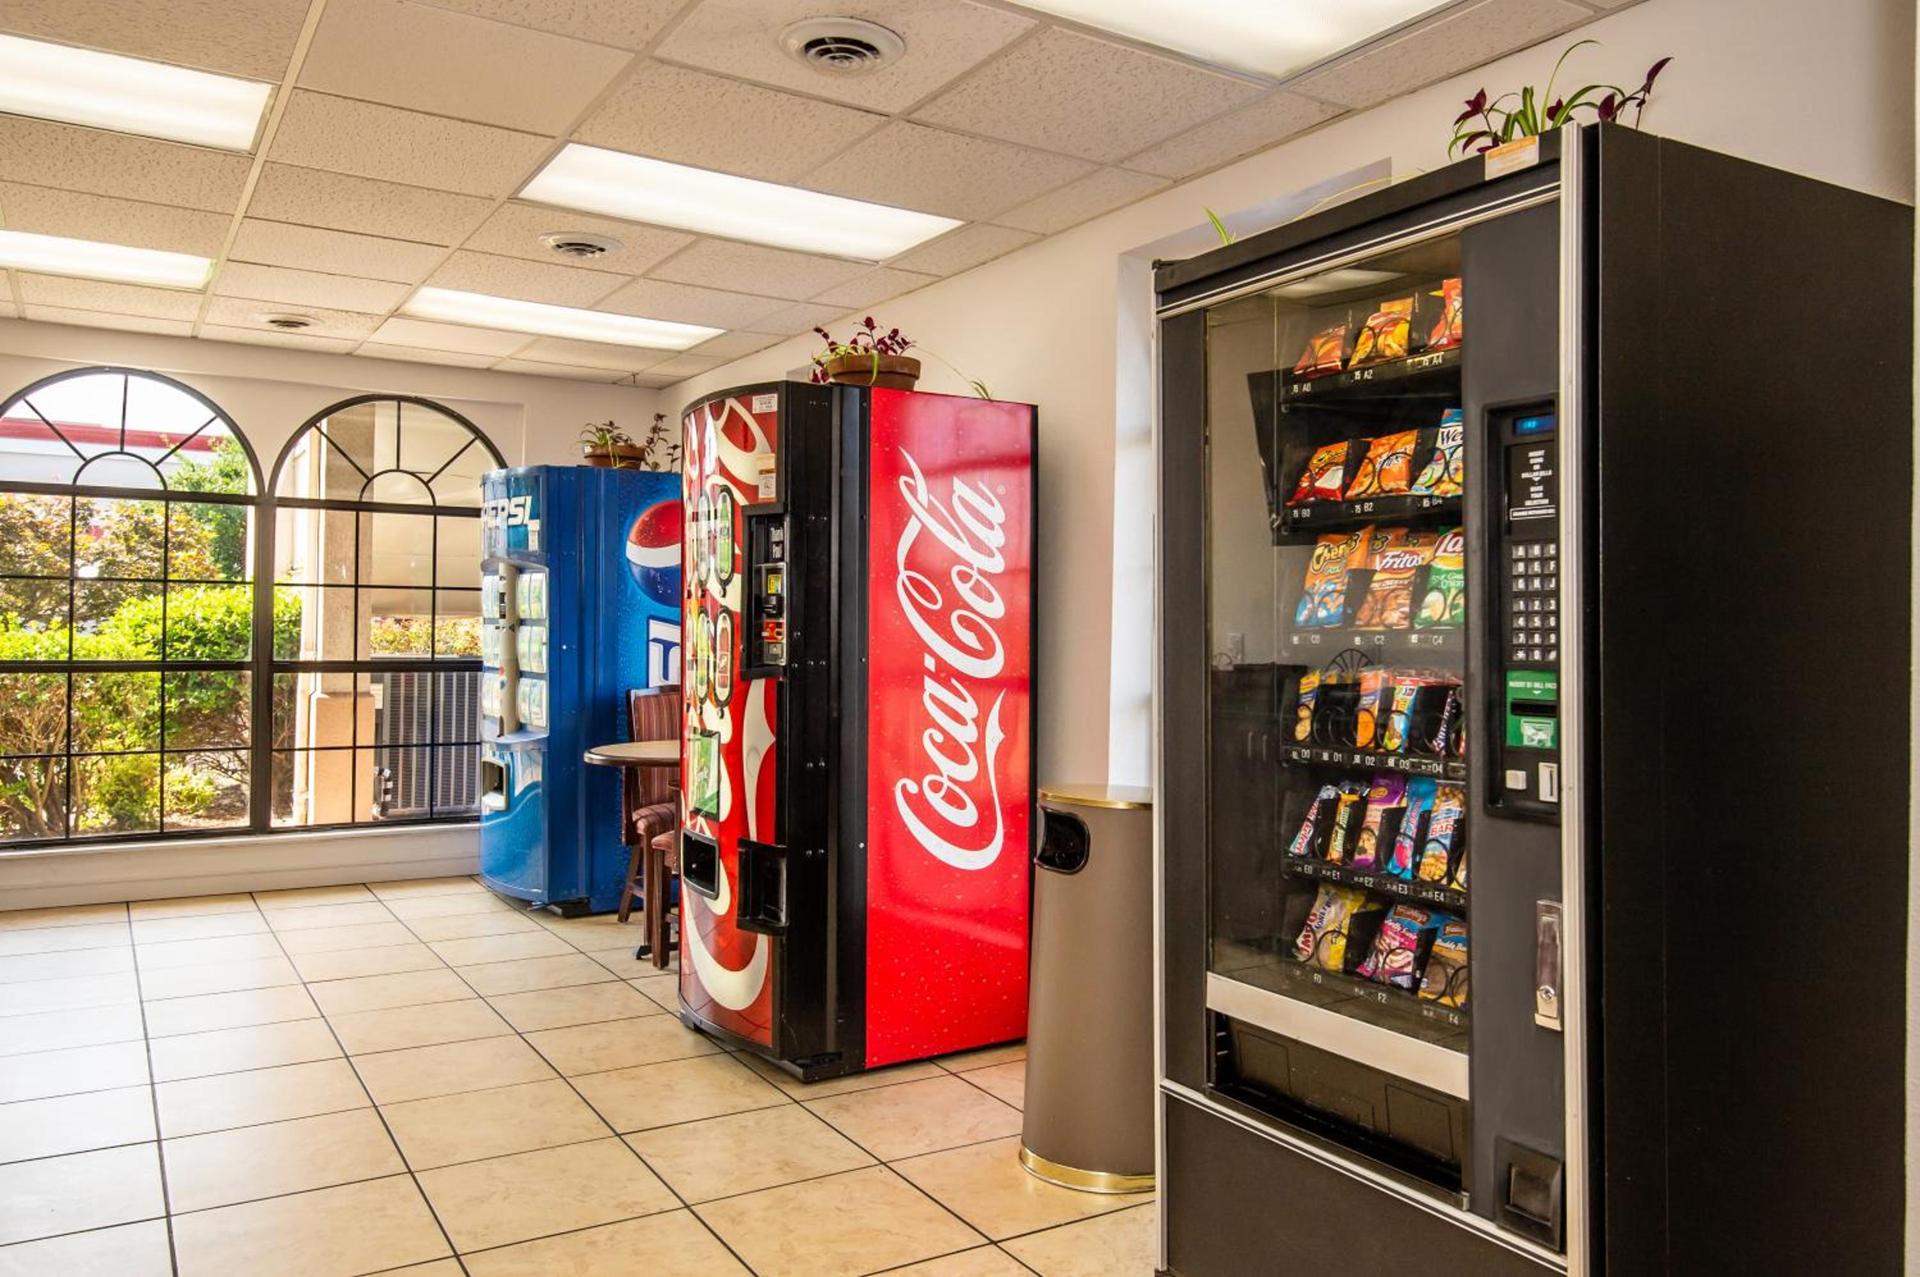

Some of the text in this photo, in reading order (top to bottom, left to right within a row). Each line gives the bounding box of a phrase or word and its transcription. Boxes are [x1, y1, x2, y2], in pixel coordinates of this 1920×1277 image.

[1377, 550, 1425, 571] Fritos
[1374, 635, 1385, 645] C2
[1432, 635, 1443, 646] C4
[896, 446, 1006, 870] Coca-Cola
[1398, 883, 1408, 895] E3
[1434, 891, 1445, 902] E4
[1377, 992, 1387, 1004] F2
